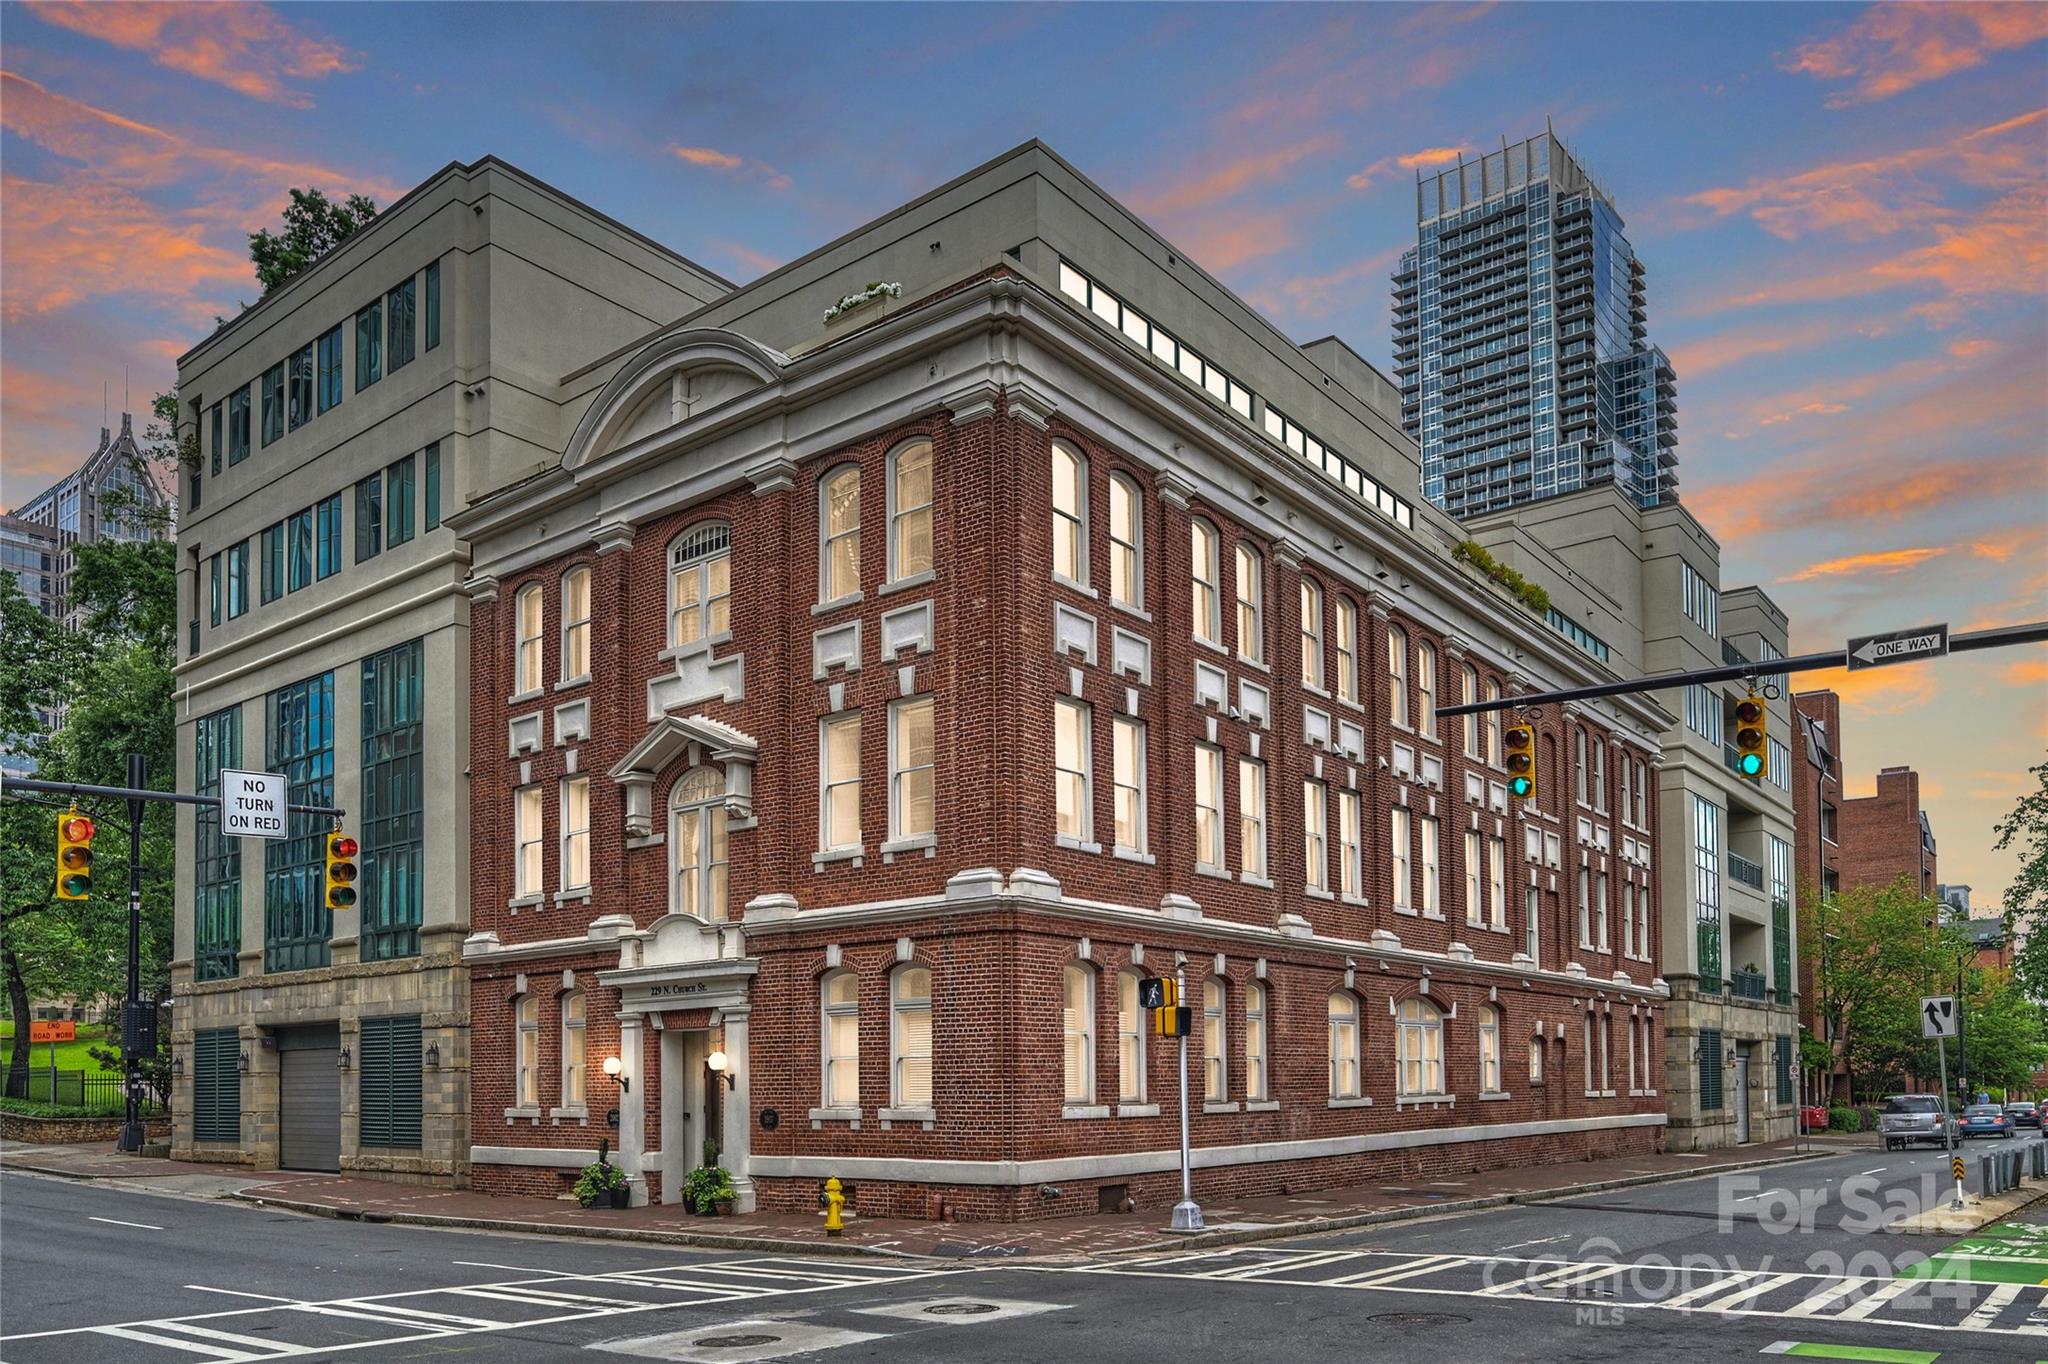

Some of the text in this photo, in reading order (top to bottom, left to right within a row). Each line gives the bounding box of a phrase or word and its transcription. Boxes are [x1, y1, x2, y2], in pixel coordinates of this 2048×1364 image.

[1876, 635, 1936, 656] ONE WAY
[243, 779, 266, 793] NO
[236, 797, 273, 812] TURN
[229, 814, 281, 830] ON RED
[33, 1031, 73, 1040] ROAD WORK
